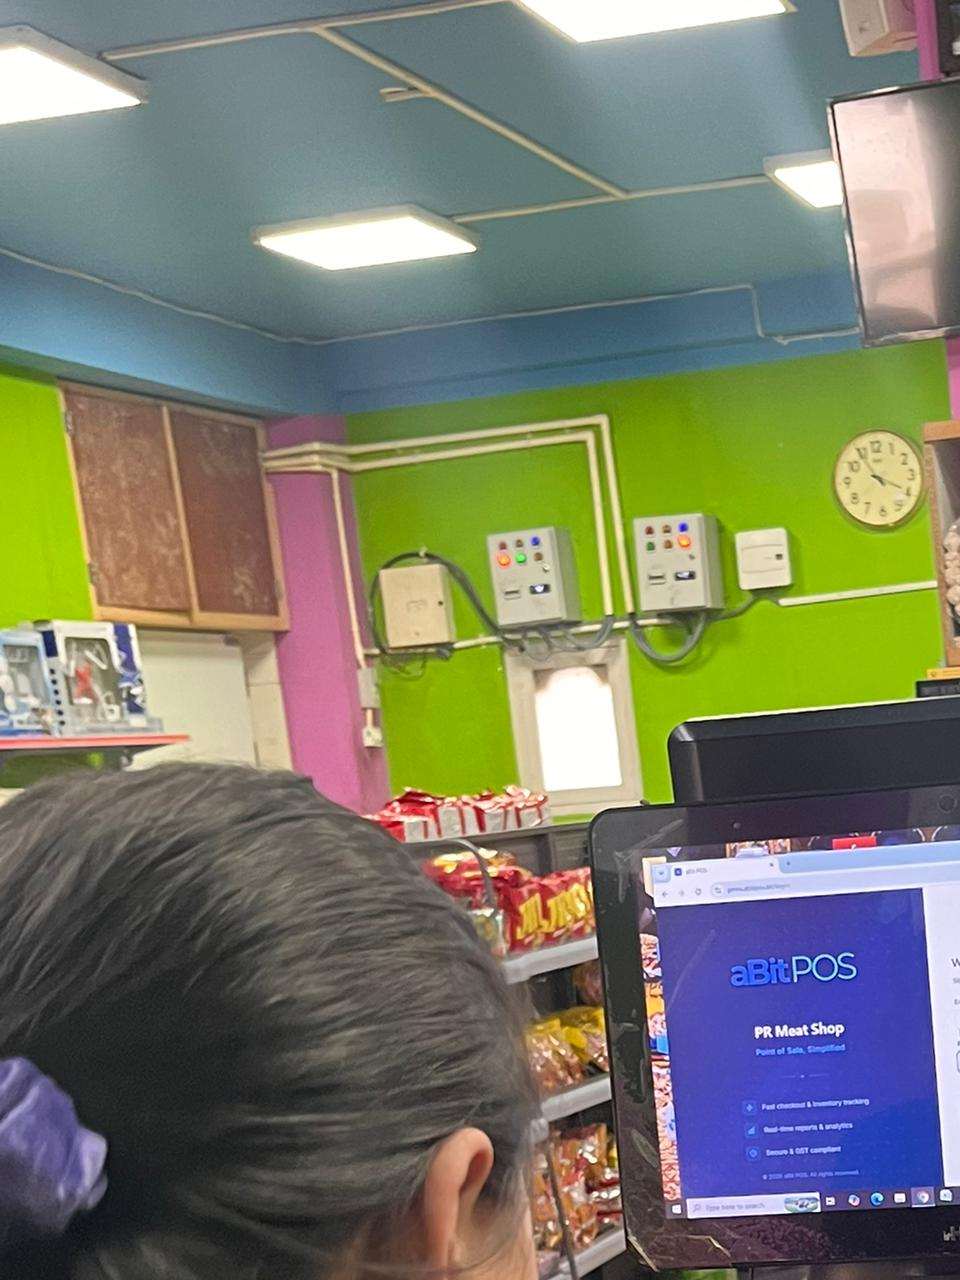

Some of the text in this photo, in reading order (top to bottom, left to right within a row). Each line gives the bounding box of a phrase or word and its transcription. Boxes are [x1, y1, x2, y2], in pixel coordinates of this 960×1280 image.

[870, 440, 882, 453] 12
[900, 452, 908, 465] 2
[907, 468, 915, 480] 3
[843, 476, 852, 488] 9
[851, 492, 859, 504] 8
[864, 501, 872, 514] 7
[730, 952, 858, 987] aBitPOS
[754, 1020, 846, 1040] PR Meat Shop
[756, 1047, 776, 1057] Point
[776, 1046, 786, 1056] of
[761, 1102, 776, 1111] Fast
[825, 1121, 854, 1131] analytics
